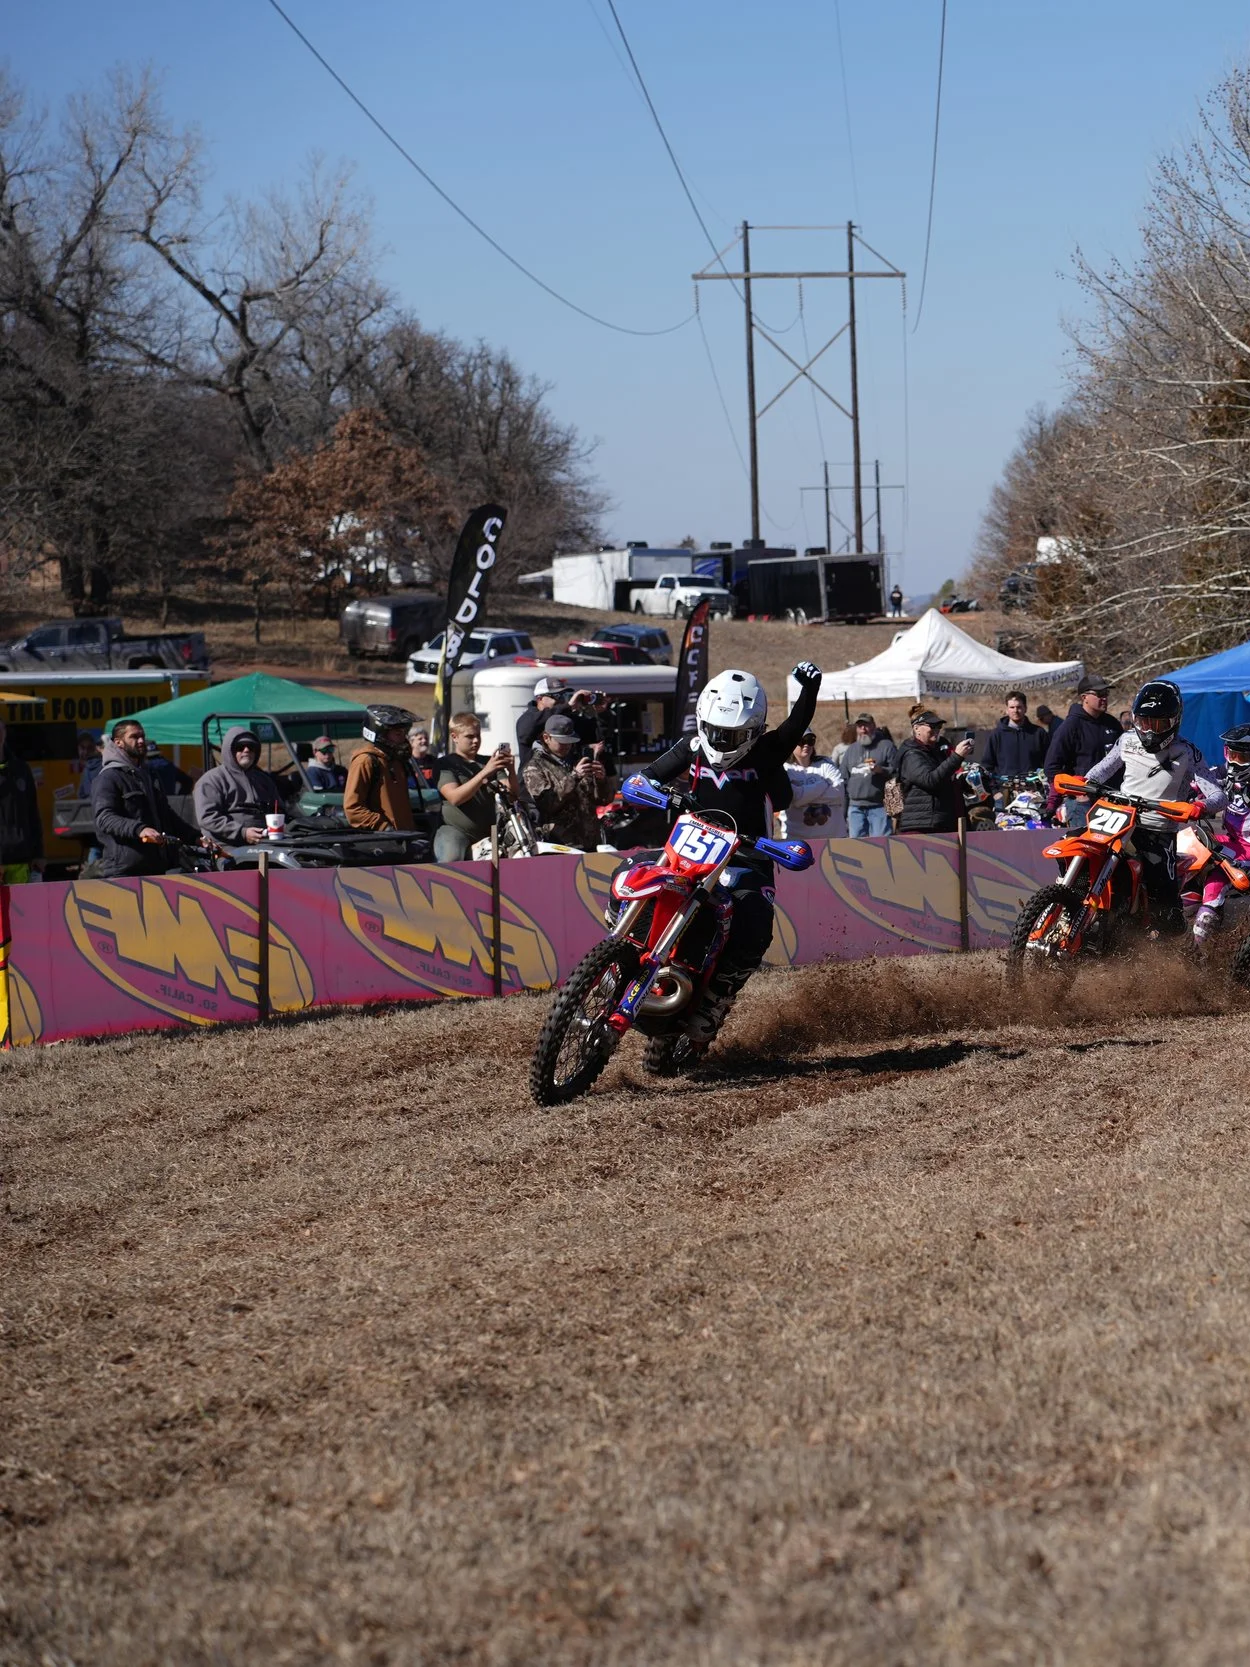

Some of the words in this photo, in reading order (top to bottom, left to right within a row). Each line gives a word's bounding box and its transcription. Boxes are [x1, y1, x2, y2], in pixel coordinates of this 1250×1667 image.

[455, 516, 503, 624] COLD
[925, 679, 964, 695] BURGERS
[967, 683, 985, 695] HOT
[8, 701, 46, 721] THE
[52, 697, 104, 720] FOOD
[1089, 808, 1128, 835] 20
[673, 825, 727, 864] 151
